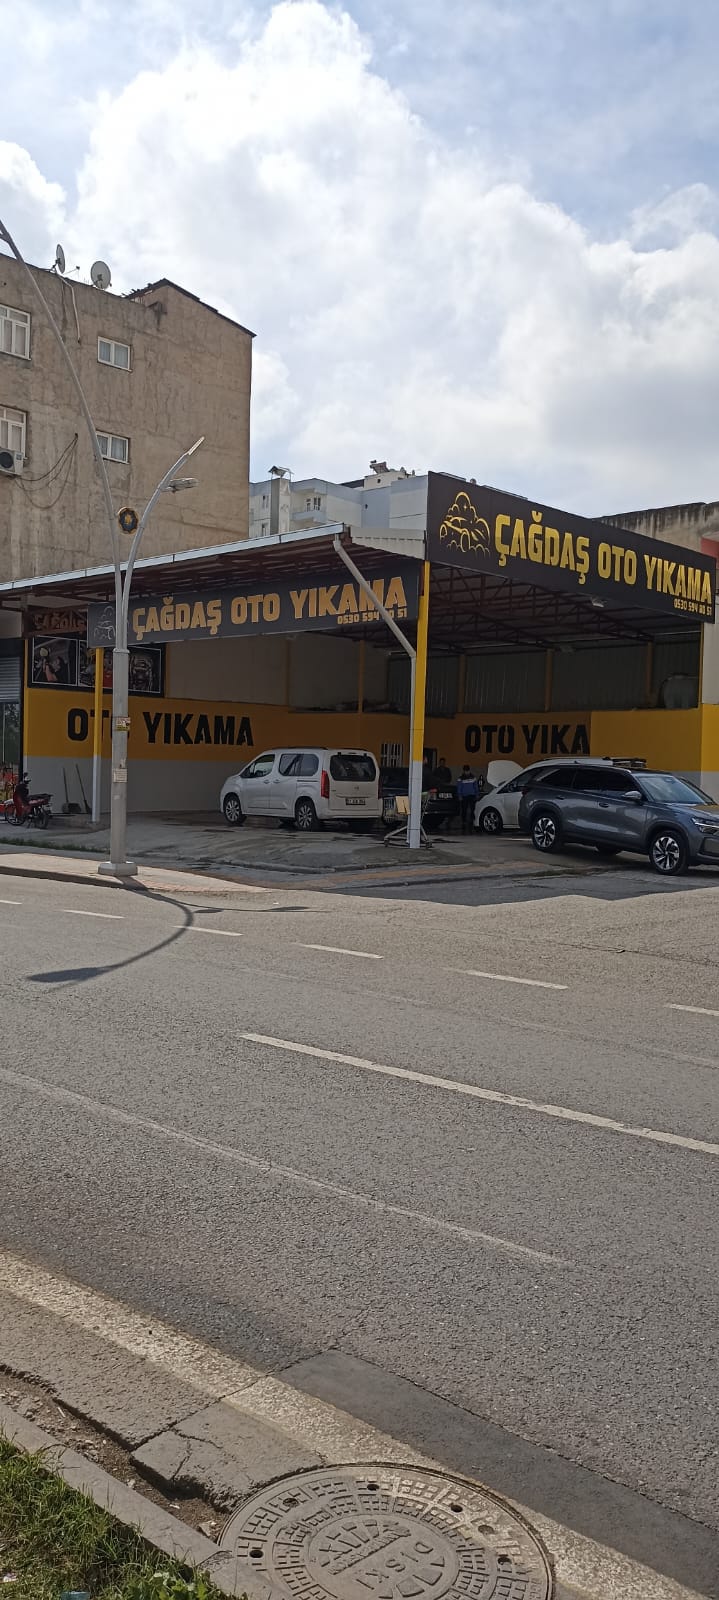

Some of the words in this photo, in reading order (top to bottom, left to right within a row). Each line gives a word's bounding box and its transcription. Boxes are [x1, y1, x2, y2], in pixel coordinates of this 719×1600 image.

[494, 510, 590, 585] ÇAĞDAŞ
[597, 542, 638, 585] OTO
[643, 554, 713, 604] YIKAMA
[132, 596, 222, 641] ÇAĞDAŞ
[230, 593, 281, 625] OTO
[289, 577, 408, 619] YIKAMA
[338, 614, 359, 624] 0530
[363, 612, 379, 622] 594
[674, 599, 688, 611] 0530
[688, 602, 698, 612] 594
[143, 711, 254, 747] YIKAMA
[464, 724, 515, 754] OTO
[521, 724, 591, 755] YIKA
